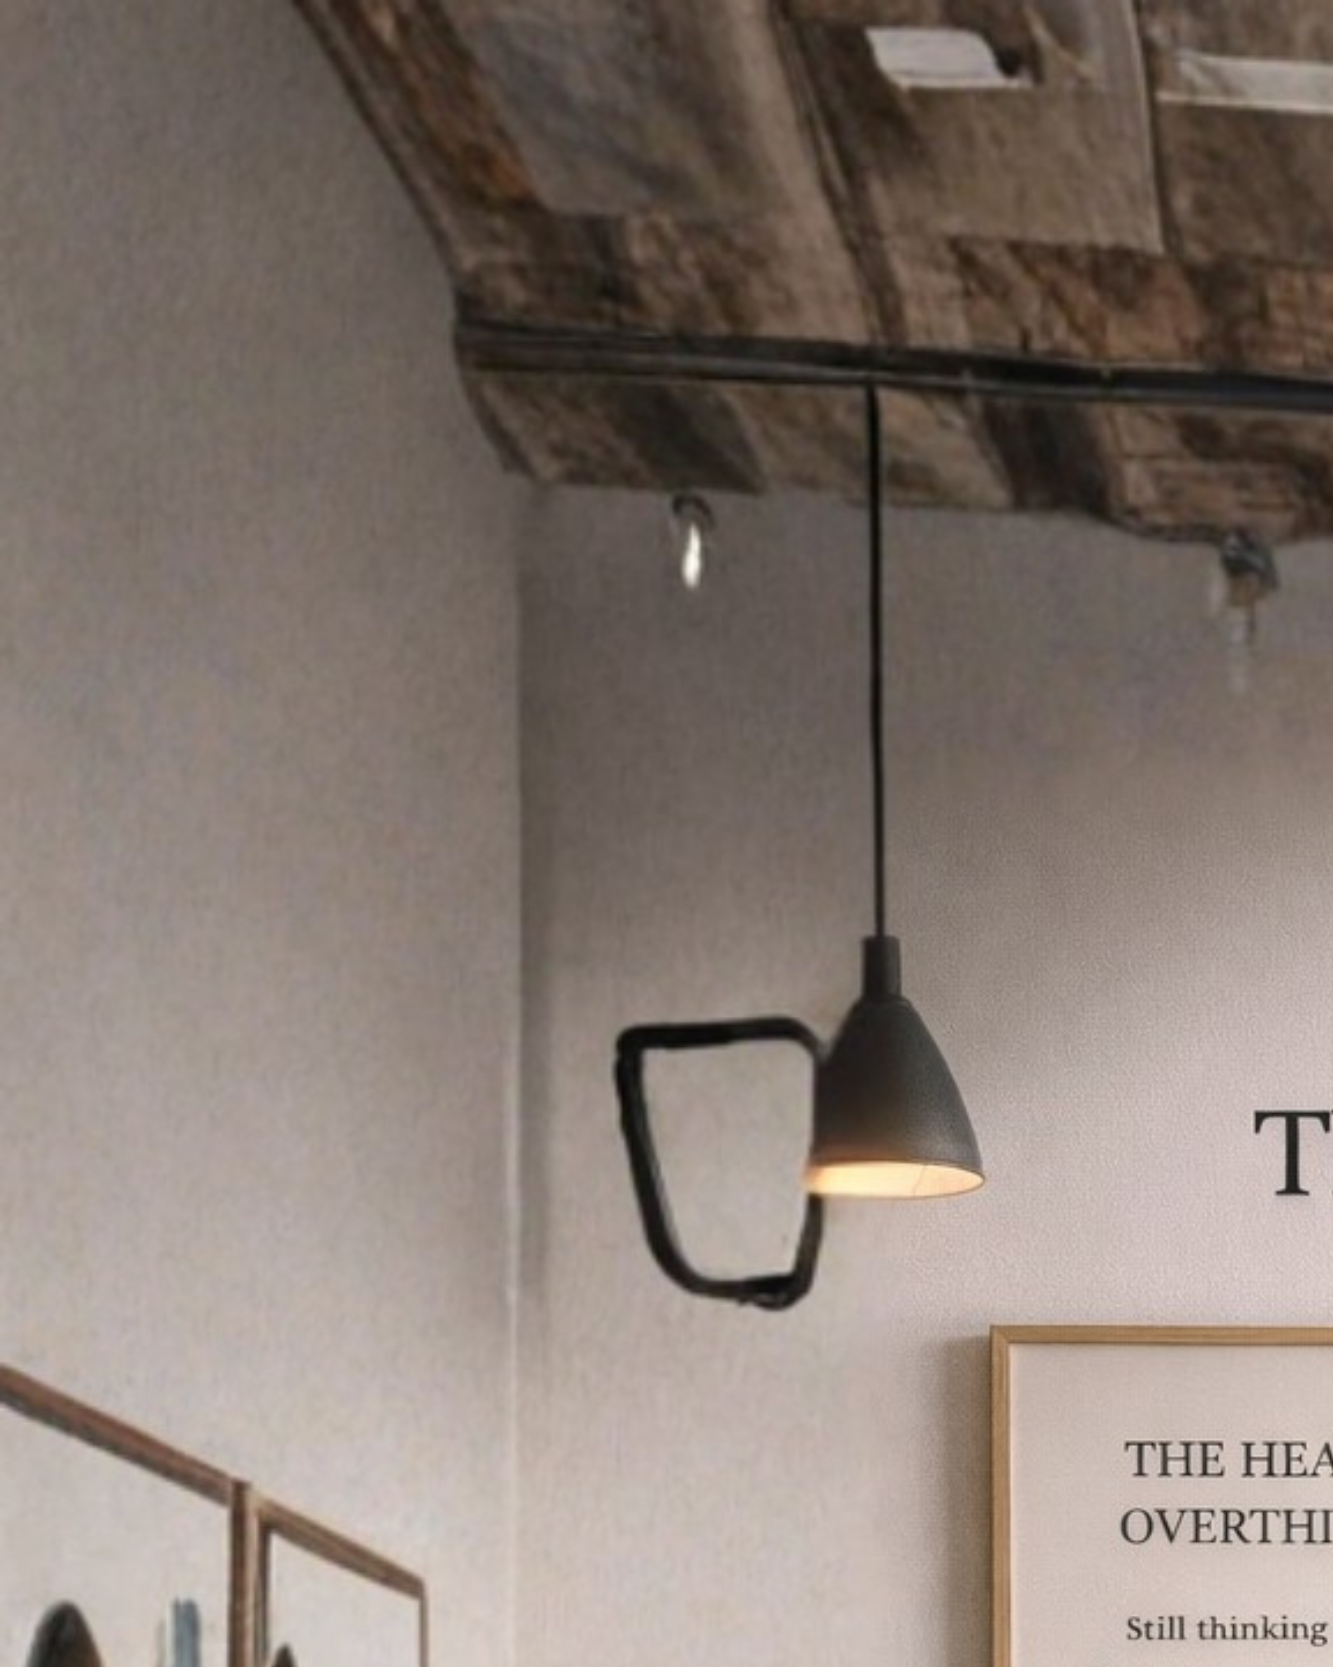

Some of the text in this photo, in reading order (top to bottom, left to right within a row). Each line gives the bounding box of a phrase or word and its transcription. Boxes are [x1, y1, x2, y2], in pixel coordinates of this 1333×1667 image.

[1124, 1441, 1225, 1478] THE
[1126, 1615, 1186, 1641] Still
[1197, 1615, 1328, 1647] thinking
